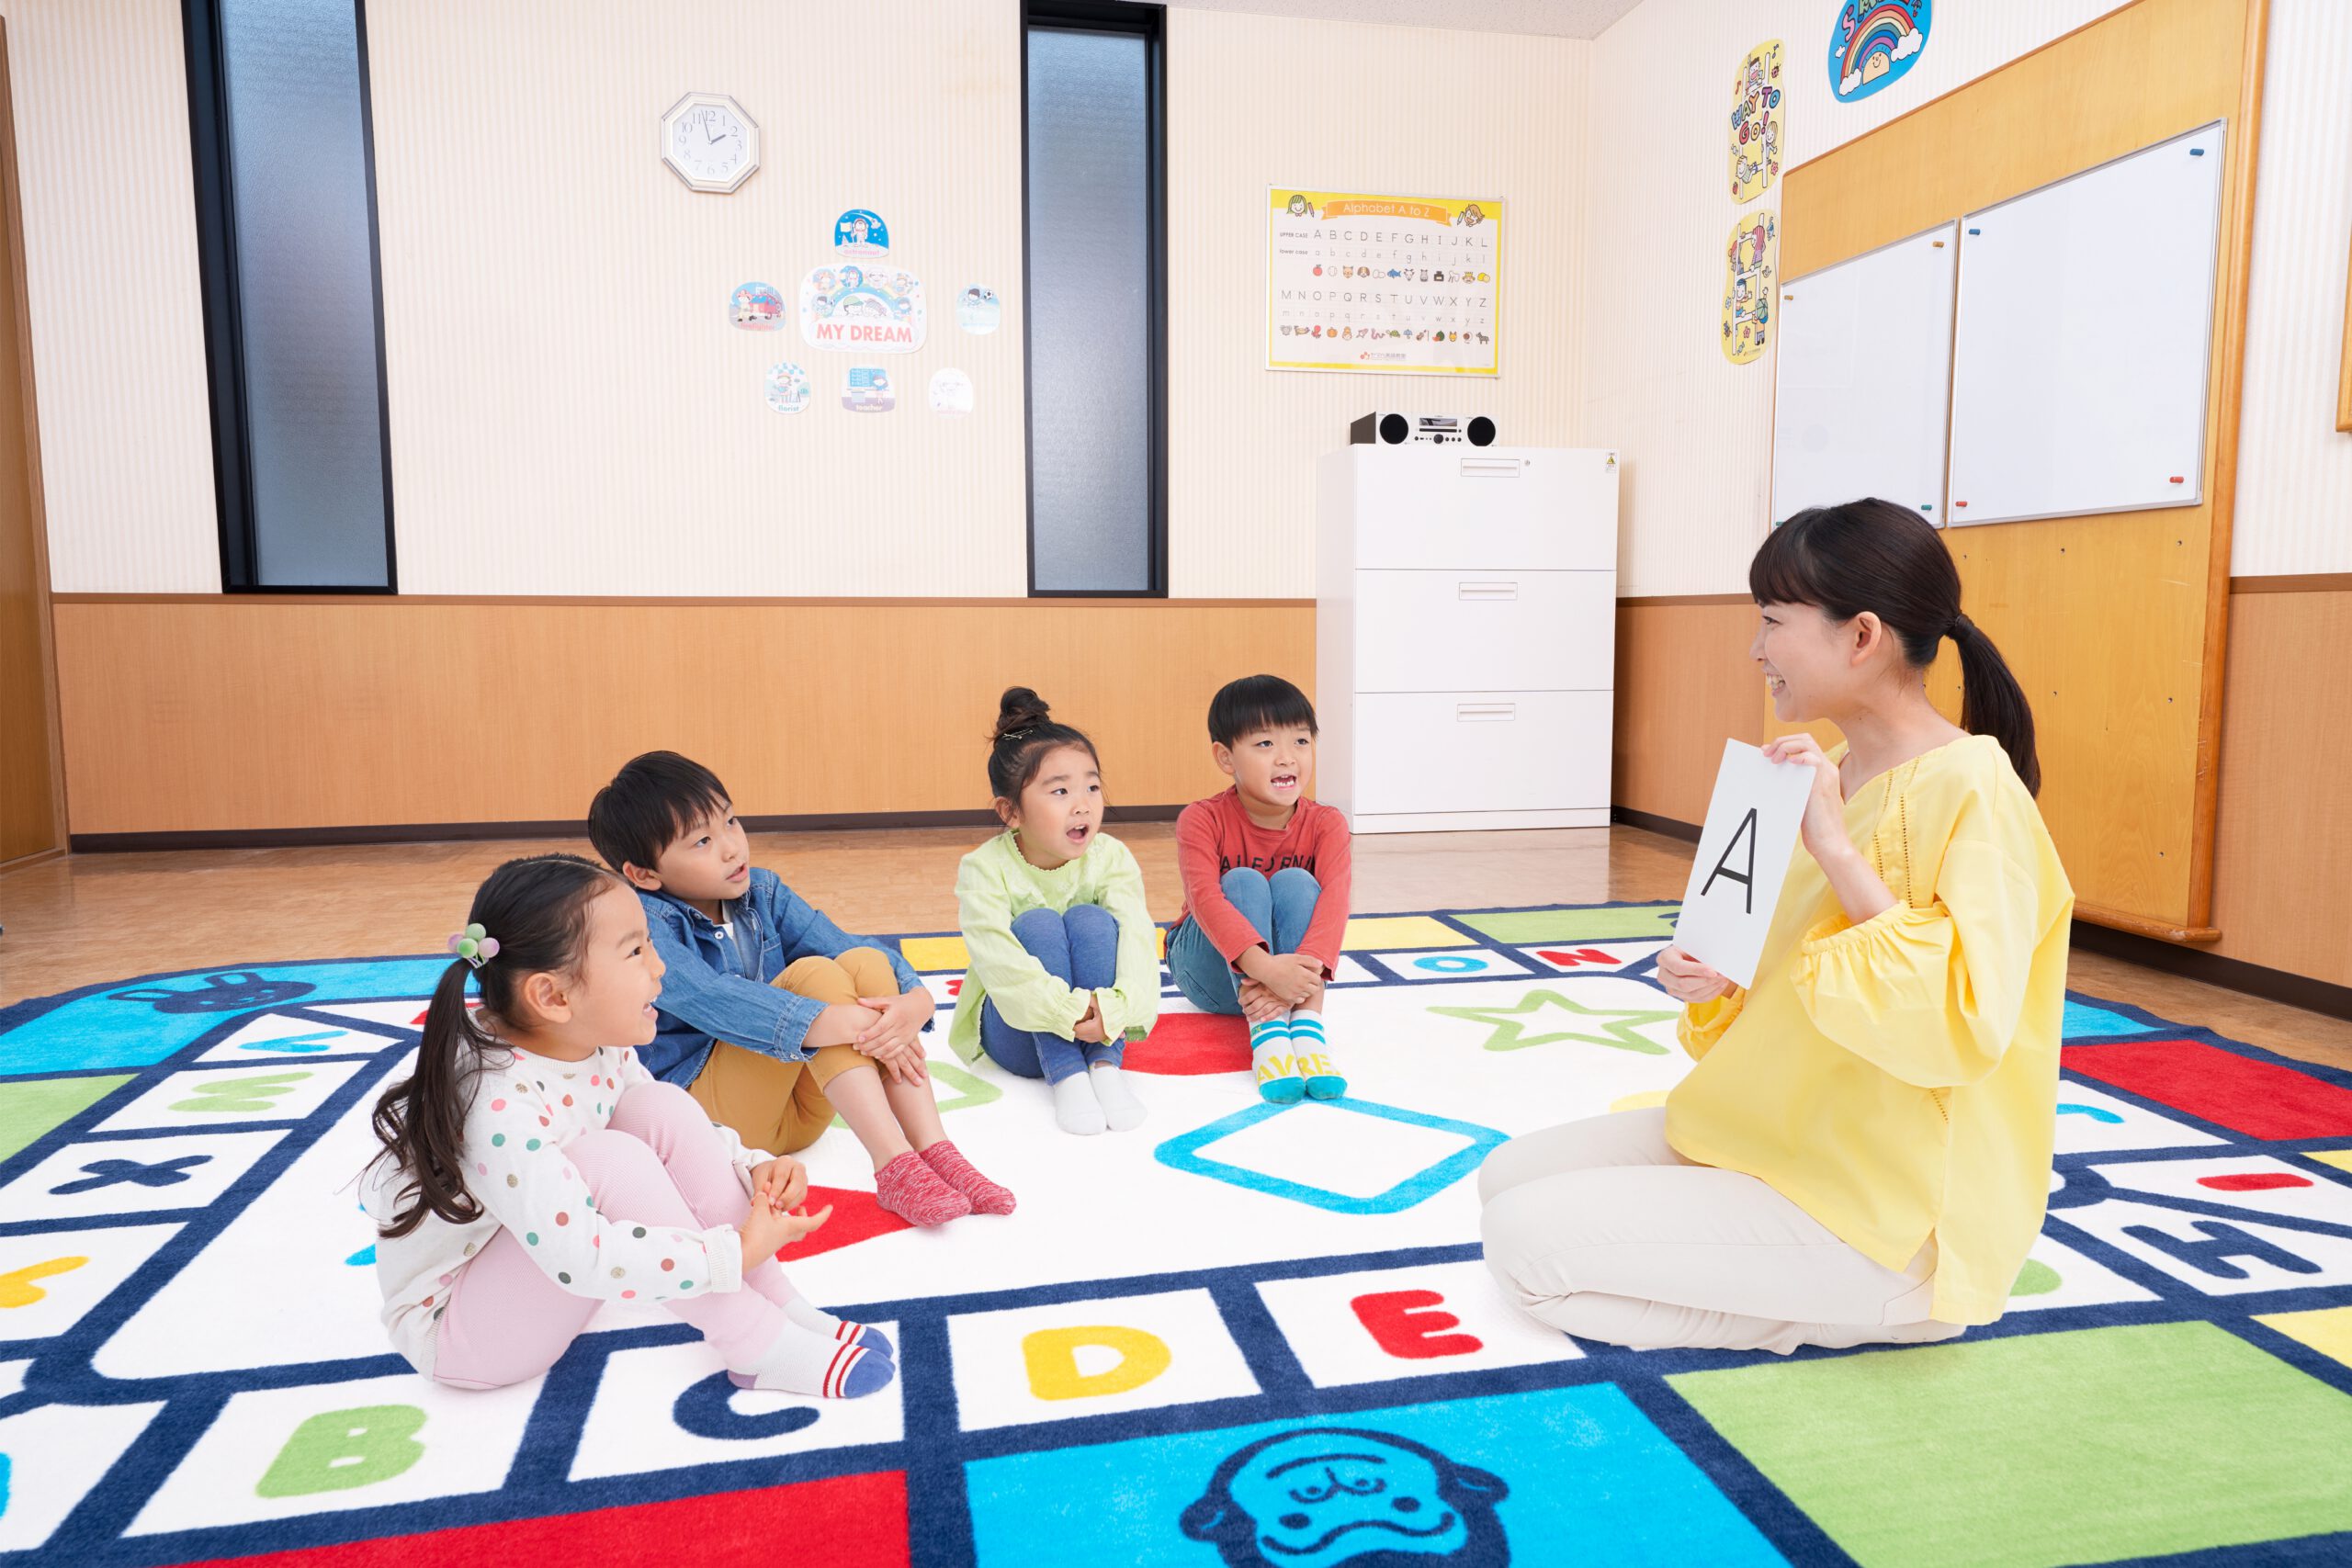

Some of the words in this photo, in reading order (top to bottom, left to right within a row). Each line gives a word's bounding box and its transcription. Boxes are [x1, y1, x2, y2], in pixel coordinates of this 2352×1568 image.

[705, 110, 716, 122] 12
[1731, 91, 1759, 130] WAY
[1762, 86, 1781, 108] TO
[682, 121, 693, 133] 10
[693, 113, 701, 124] 11
[722, 115, 726, 127] 1
[730, 126, 738, 137] 2
[1739, 111, 1770, 145] GO!
[679, 136, 686, 145] 9
[736, 140, 742, 151] 3
[707, 164, 715, 175] 6
[721, 162, 729, 173] 5
[1343, 203, 1395, 214] Alphabet
[1398, 206, 1406, 214] A
[1410, 206, 1421, 216] to
[1424, 208, 1430, 217] Z
[1314, 230, 1322, 239] A
[1329, 231, 1337, 240] B
[1343, 231, 1352, 241] C
[1360, 231, 1369, 242] D
[1375, 232, 1383, 243] E
[1391, 233, 1398, 243] F
[1404, 234, 1414, 243] G
[1421, 235, 1429, 244] H
[1451, 237, 1458, 246] J
[1465, 238, 1474, 247] K
[1480, 239, 1488, 248] L
[1281, 290, 1292, 299] M
[1298, 291, 1306, 300] N
[1312, 291, 1322, 301] O
[1329, 292, 1337, 302] P
[1343, 293, 1352, 302] Q
[1360, 293, 1367, 302] R
[1374, 294, 1382, 303] S
[1390, 294, 1398, 304] T
[1405, 295, 1413, 305] U
[1419, 296, 1428, 306] V
[1432, 297, 1445, 306] W
[1449, 298, 1458, 307] X
[1465, 298, 1472, 307] Y
[1479, 299, 1487, 308] Z
[817, 323, 844, 340] MY
[850, 325, 912, 343] DREAM
[1701, 807, 1757, 915] A
[1413, 956, 1488, 973] O
[1535, 948, 1622, 966] N
[237, 1031, 349, 1053] V
[167, 1072, 315, 1112] W
[48, 1155, 215, 1195] X
[2120, 1221, 2324, 1280] H
[1350, 1289, 1484, 1359] E
[1021, 1325, 1171, 1401] D
[673, 1369, 820, 1440] C
[255, 1404, 428, 1498] B
